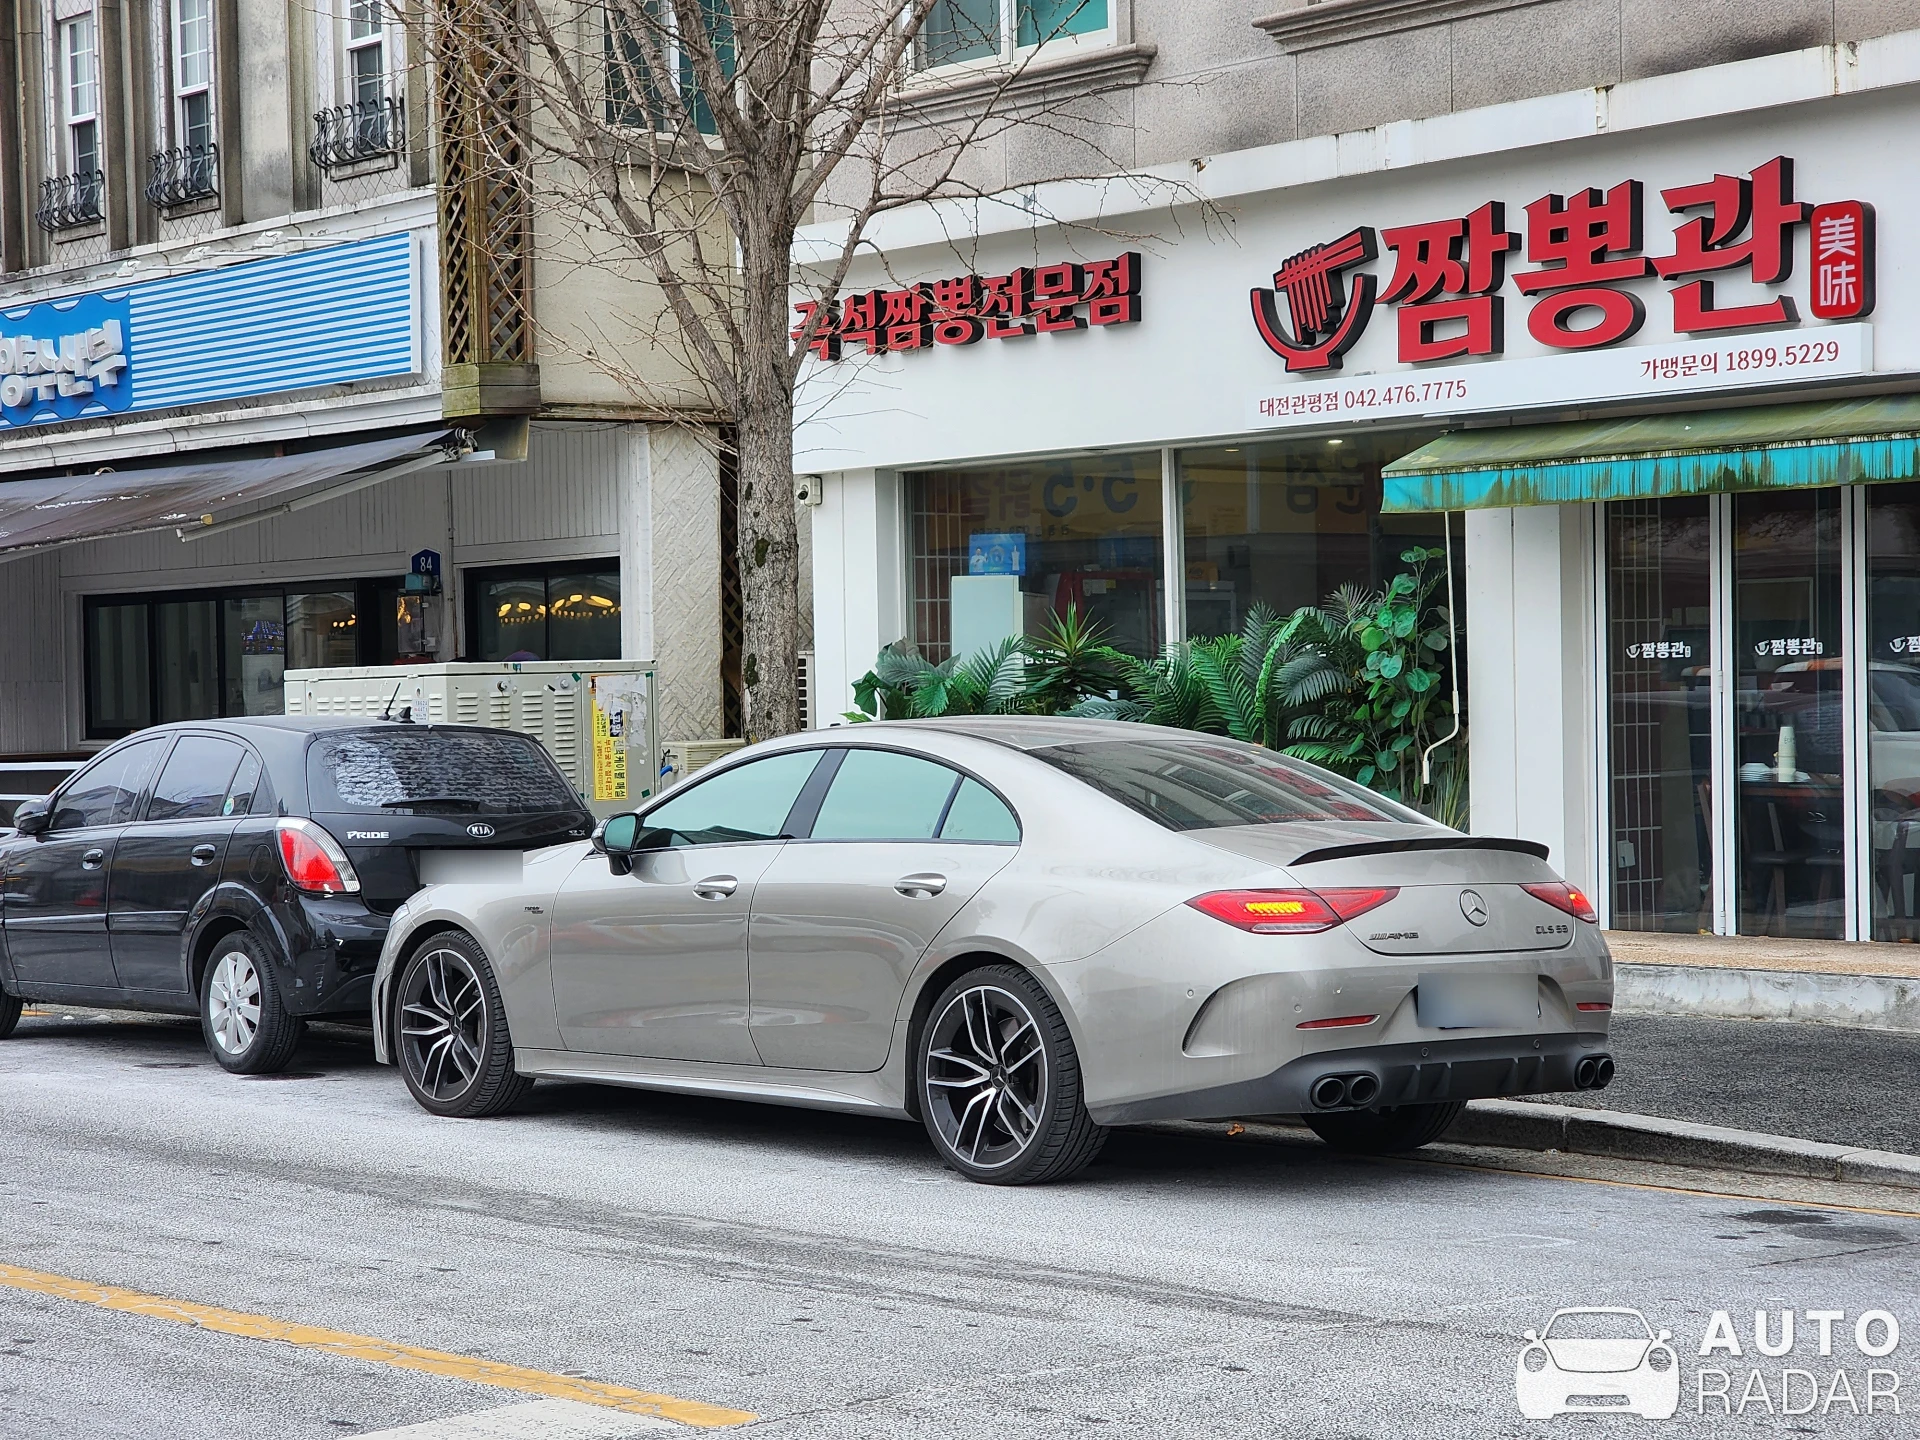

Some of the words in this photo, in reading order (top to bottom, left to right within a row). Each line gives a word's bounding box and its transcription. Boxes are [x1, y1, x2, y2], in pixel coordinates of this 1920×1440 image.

[1376, 155, 1808, 364] 짬뽕관
[1819, 214, 1857, 308] 美味
[0, 319, 127, 408] 양수산부
[1640, 351, 1718, 380] 가맹문의
[1726, 340, 1840, 371] 1899.5229
[1259, 390, 1339, 417] 대전관평점
[1344, 379, 1467, 409] 042.476.7775
[419, 556, 433, 572] 84
[1641, 641, 1685, 658] 짬뽕관
[1770, 637, 1816, 655] 짬뽕관
[346, 831, 390, 840] PRIDE
[470, 825, 491, 836] KIA
[1384, 932, 1419, 940] AMG
[1535, 925, 1554, 935] CLS
[1556, 924, 1569, 934] 53
